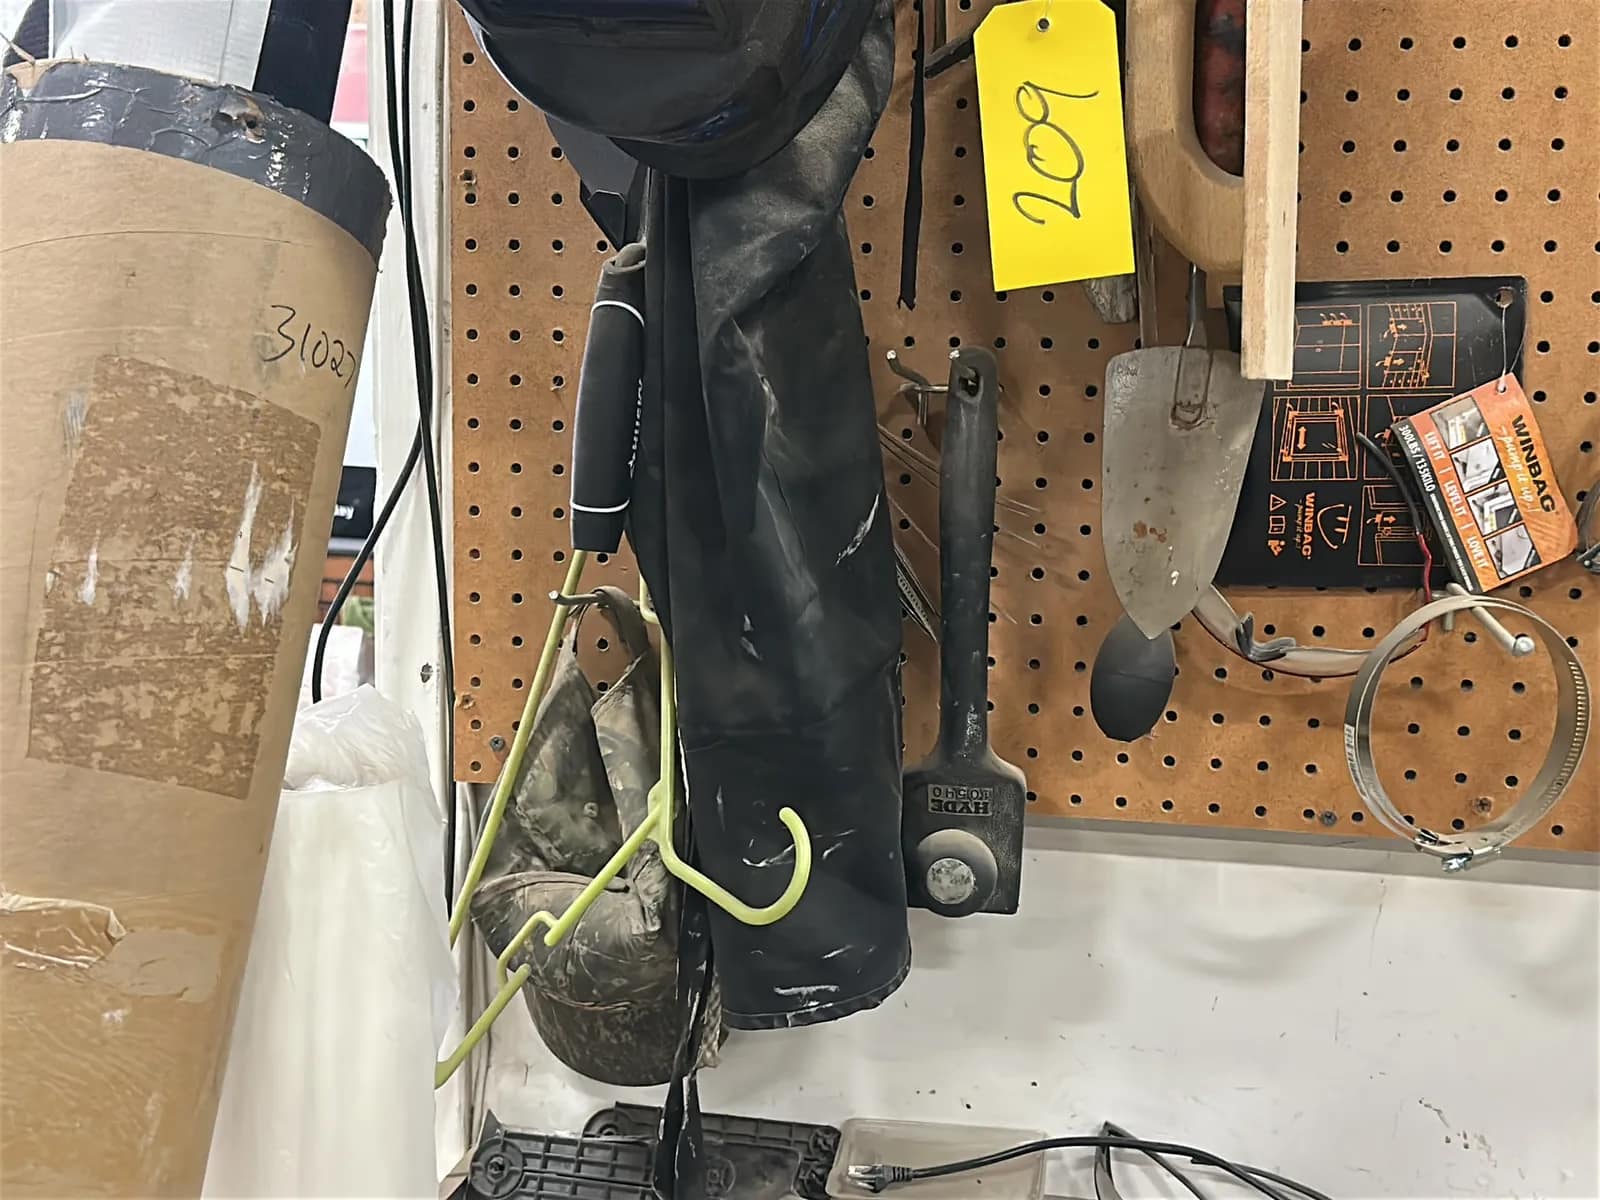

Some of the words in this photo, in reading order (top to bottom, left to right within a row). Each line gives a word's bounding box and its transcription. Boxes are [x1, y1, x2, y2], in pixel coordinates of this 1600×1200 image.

[1012, 80, 1099, 225] 209
[1424, 431, 1442, 453] LIFT
[1433, 451, 1446, 460] IT
[1512, 414, 1556, 513] WINBAG
[1444, 480, 1462, 509] LEVEL
[1454, 507, 1467, 517] IT
[1302, 492, 1316, 557] WINBAG
[1467, 535, 1485, 561] LOVE
[1475, 559, 1489, 568] IT
[930, 799, 990, 814] HYDE
